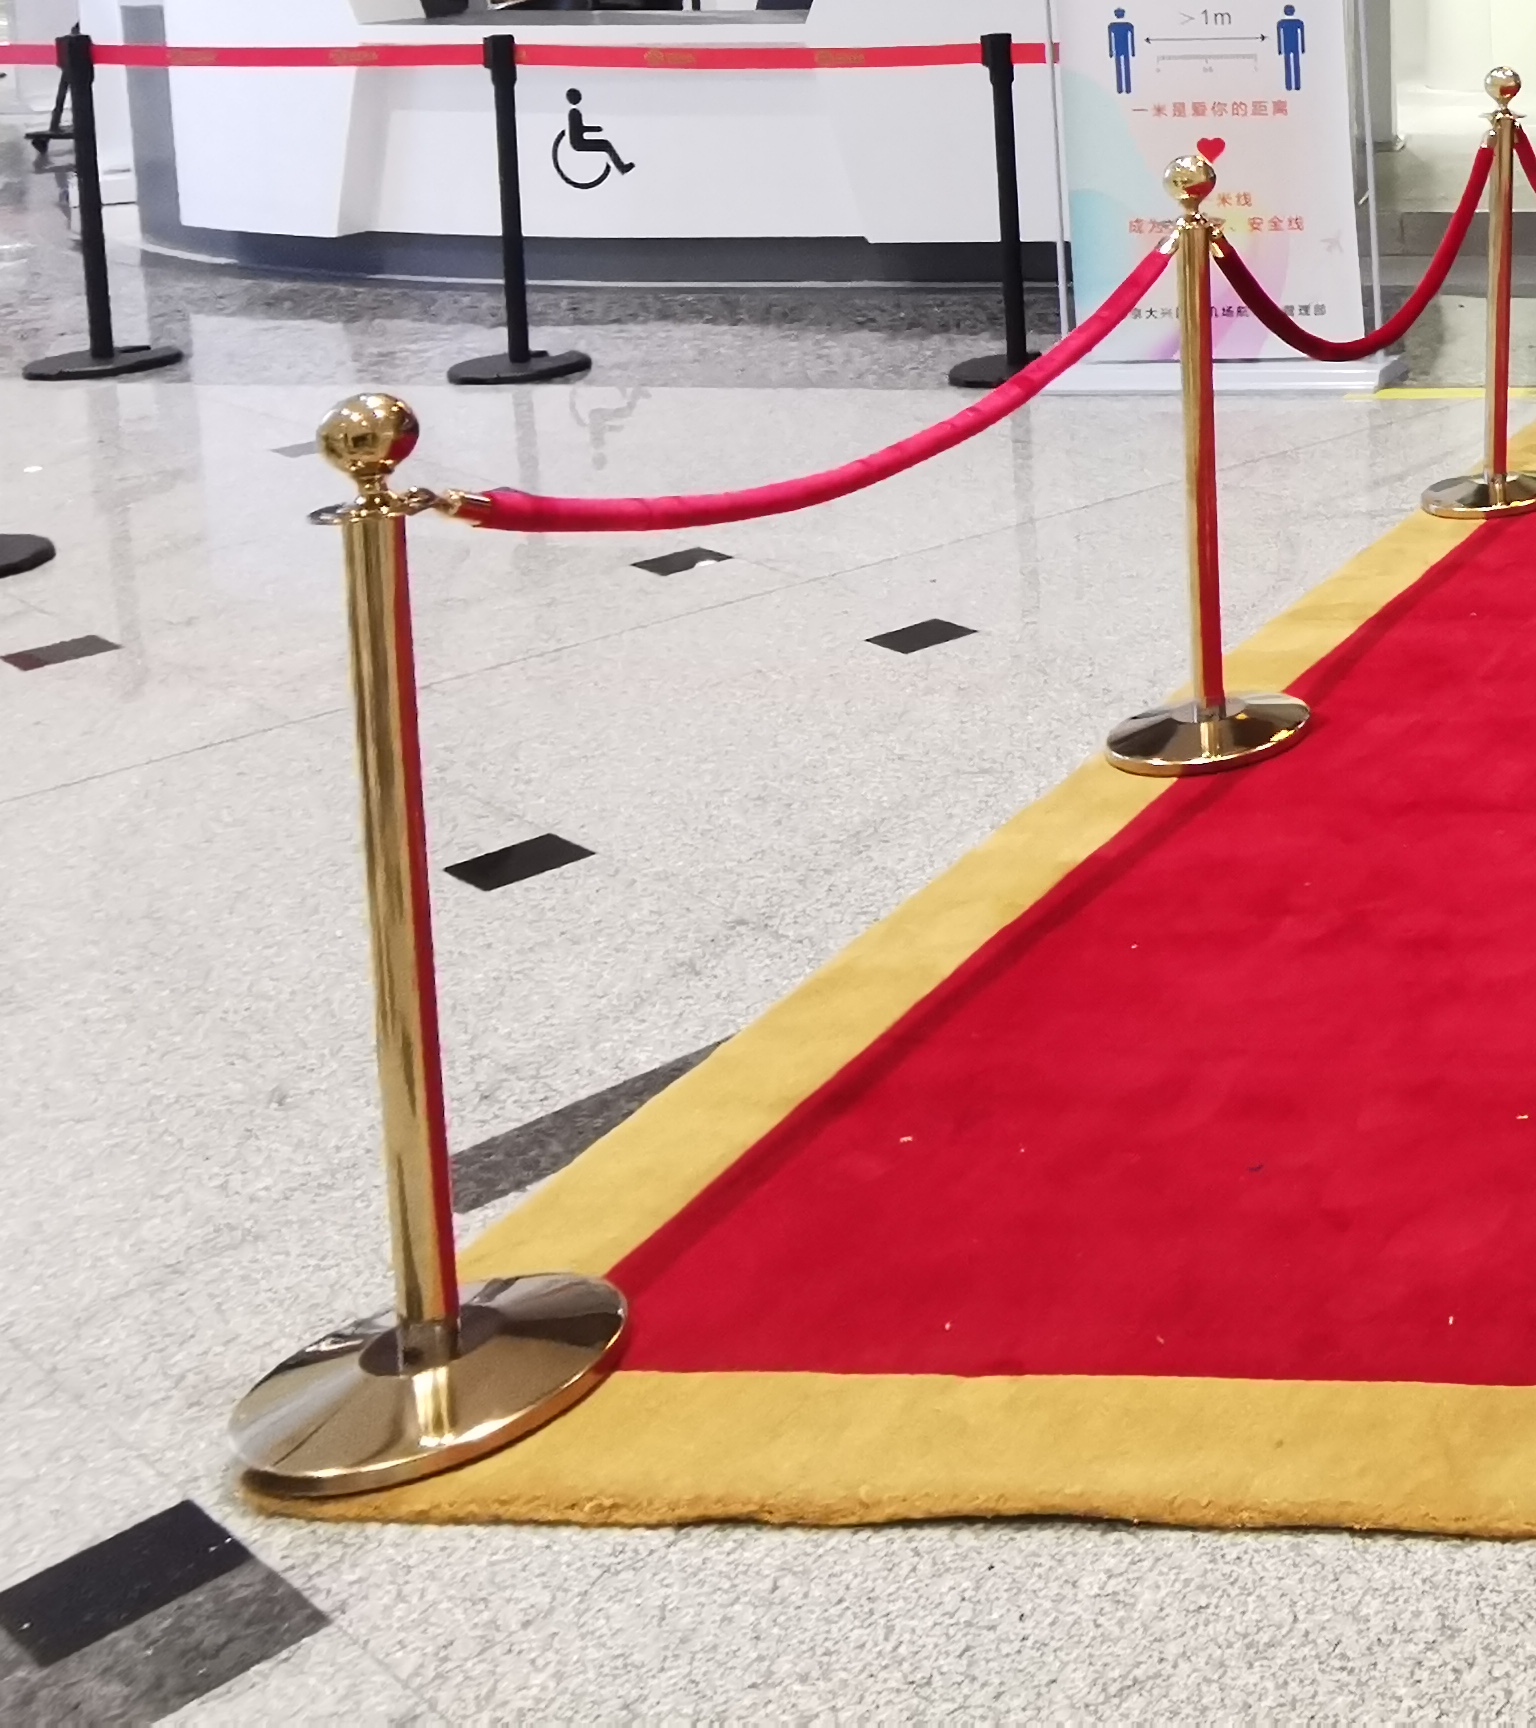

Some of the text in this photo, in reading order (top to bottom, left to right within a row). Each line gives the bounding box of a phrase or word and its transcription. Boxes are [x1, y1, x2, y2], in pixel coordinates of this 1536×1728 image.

[1132, 101, 1289, 117] 一米是爱你的距离
